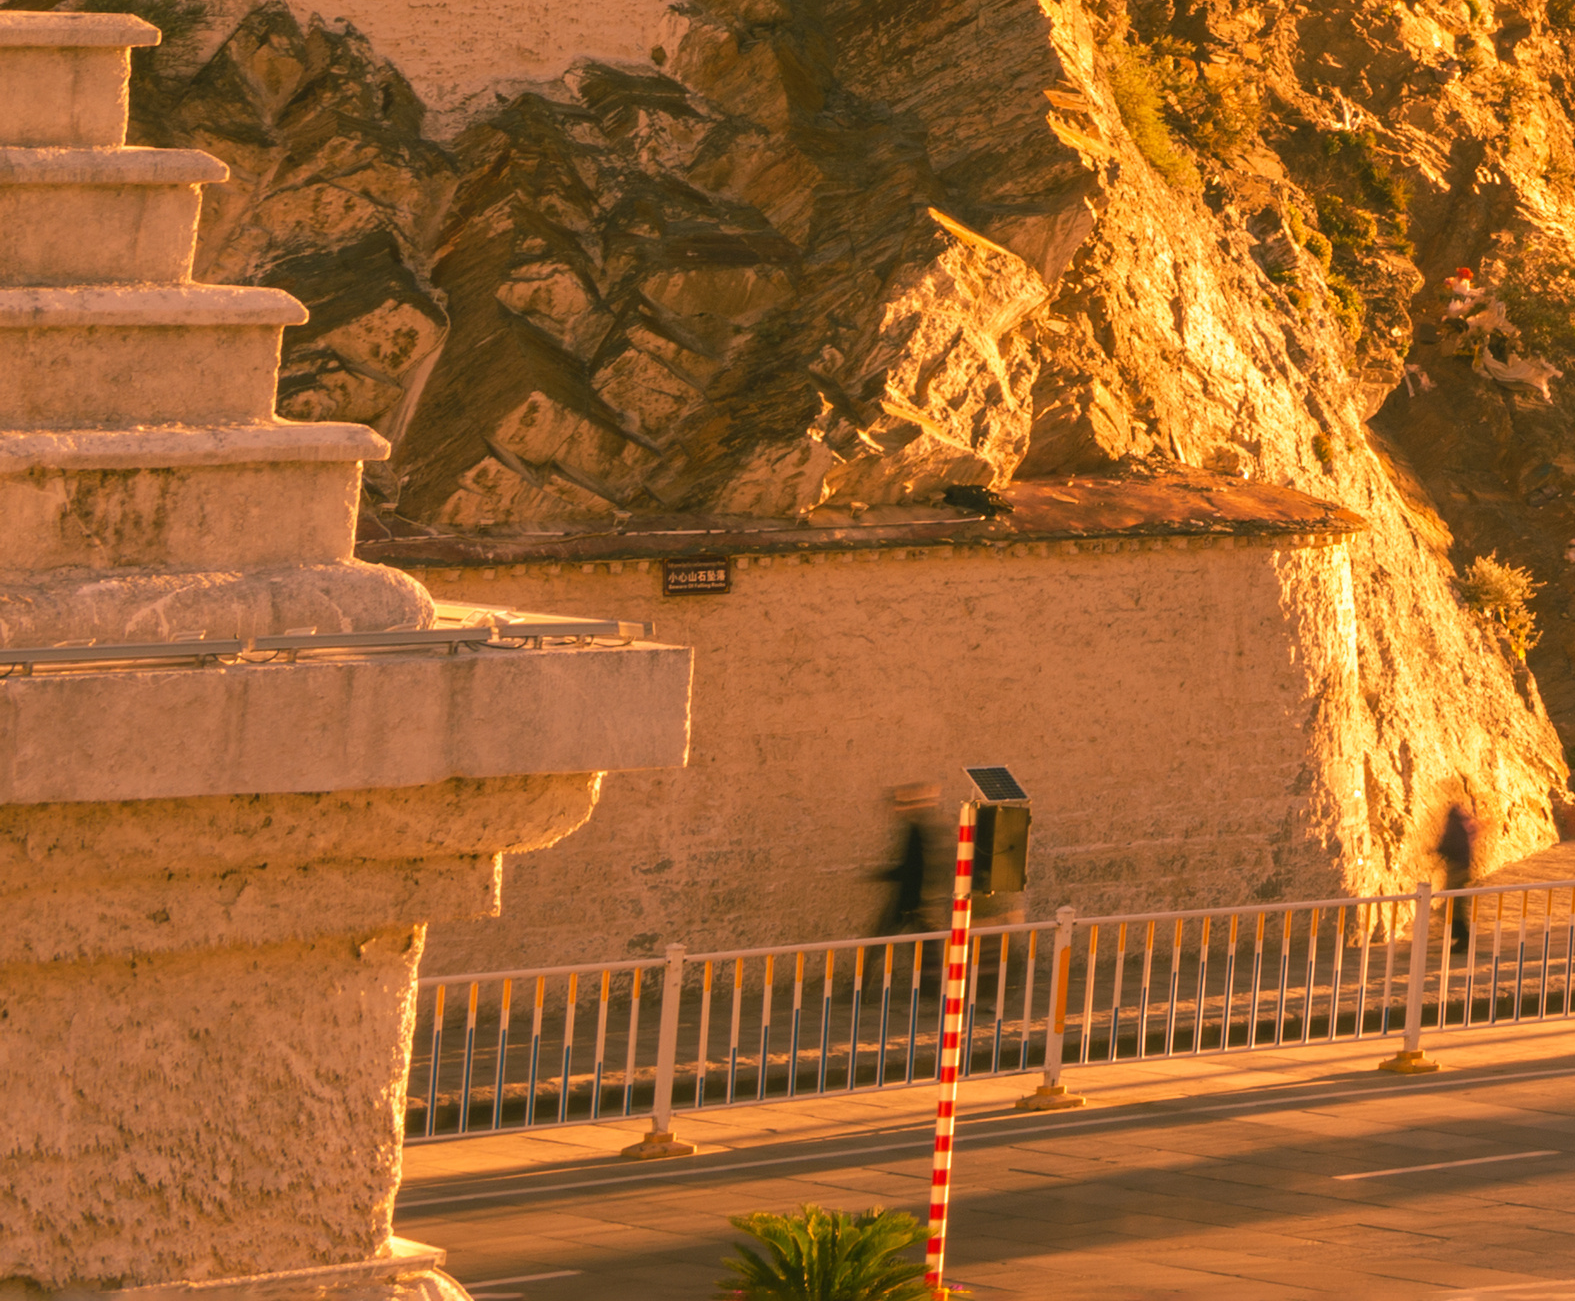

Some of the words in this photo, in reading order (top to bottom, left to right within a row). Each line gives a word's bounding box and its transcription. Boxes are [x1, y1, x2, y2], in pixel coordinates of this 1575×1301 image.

[668, 570, 726, 583] 小心山石坠落
